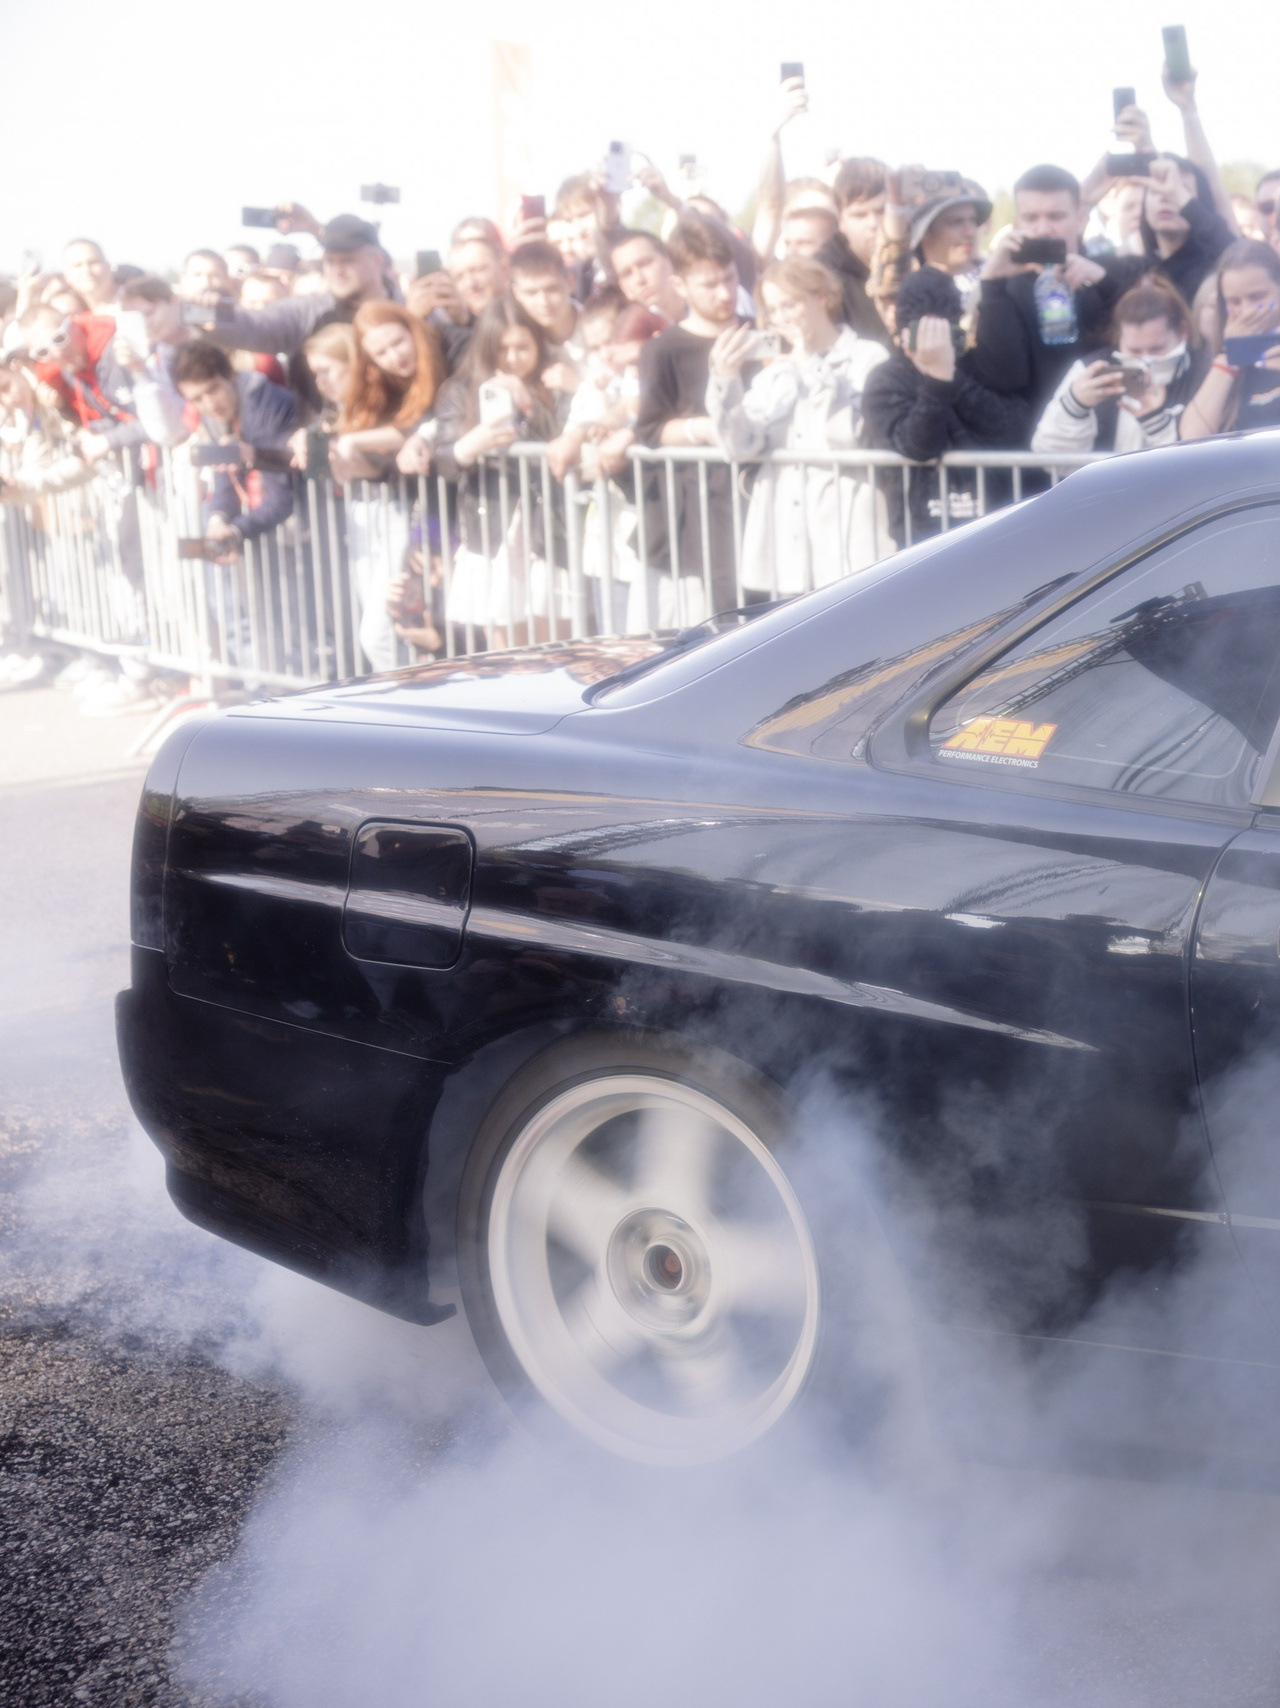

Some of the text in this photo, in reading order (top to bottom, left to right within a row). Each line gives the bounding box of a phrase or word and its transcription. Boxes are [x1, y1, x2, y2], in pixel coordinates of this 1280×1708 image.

[941, 716, 1058, 760] AEM
[938, 749, 1039, 769] PERFORMANCE ELECTRONICS
